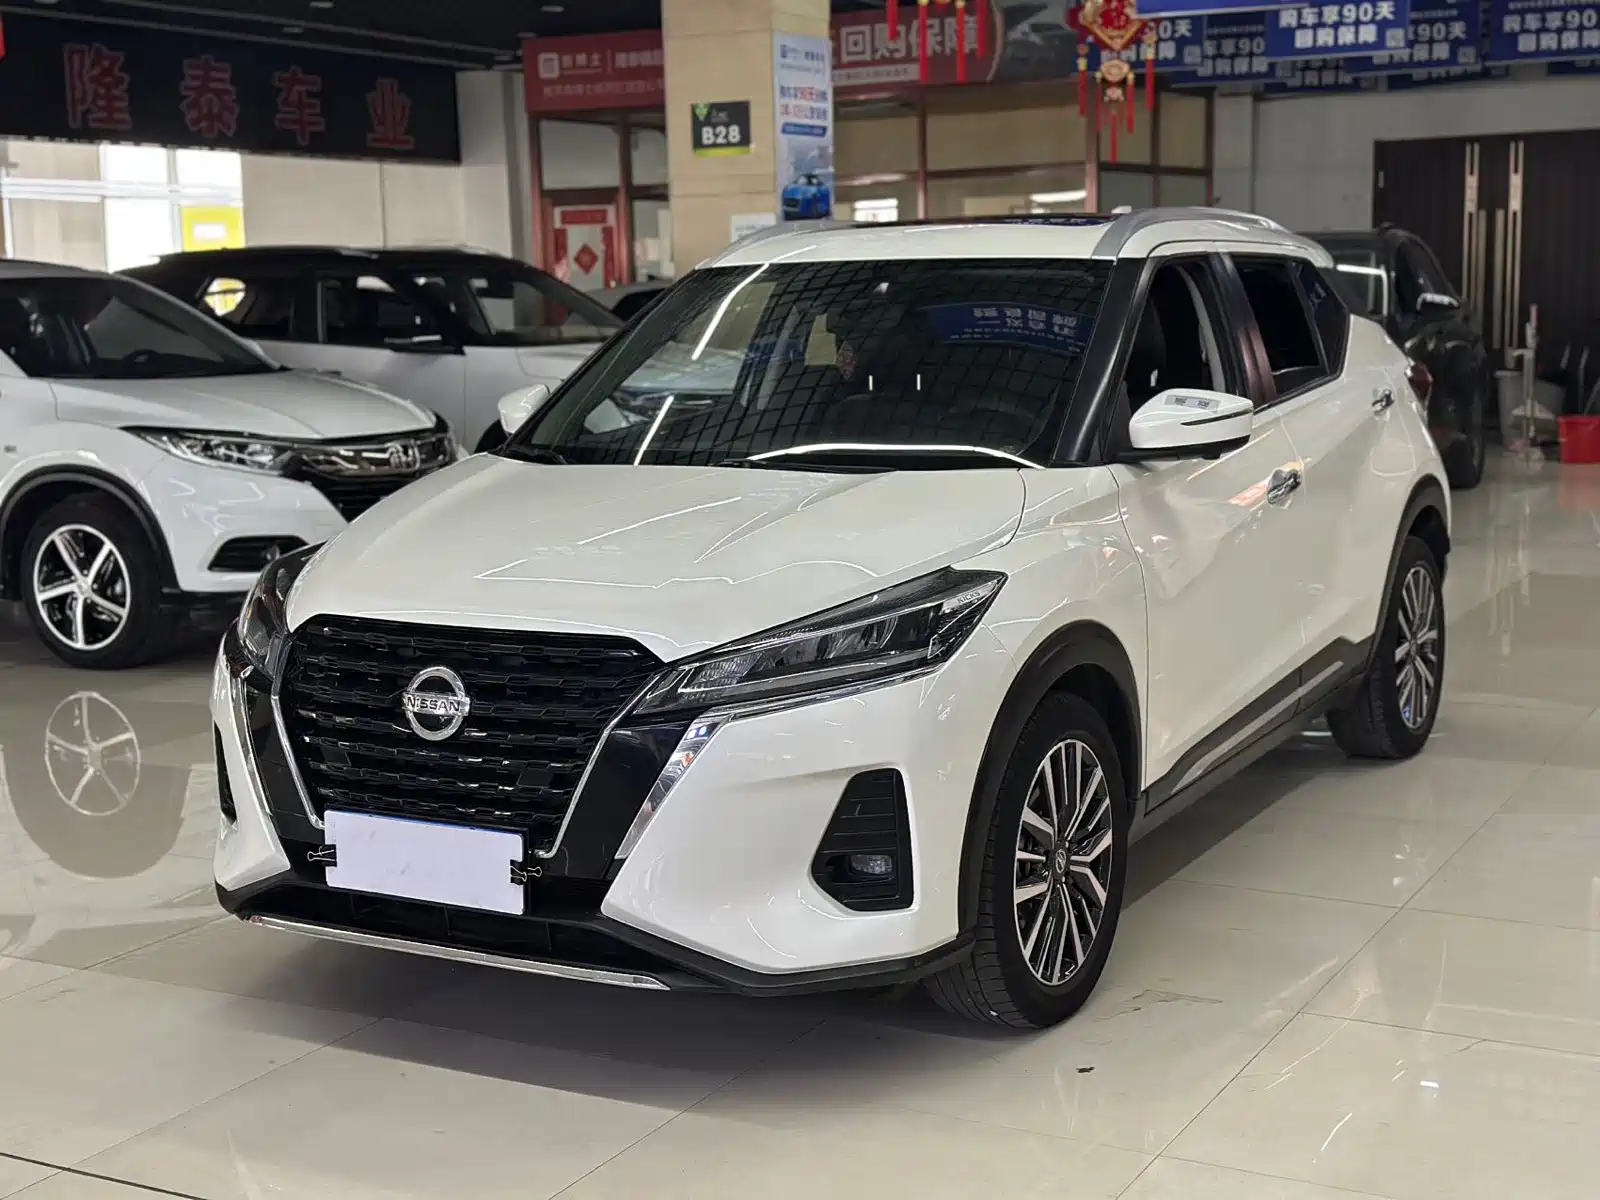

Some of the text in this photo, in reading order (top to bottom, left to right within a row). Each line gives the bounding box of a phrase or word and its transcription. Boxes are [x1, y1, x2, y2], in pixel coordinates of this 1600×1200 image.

[1279, 1, 1395, 28] 购车享90天
[64, 43, 415, 149] 隆泰车业
[701, 124, 742, 146] B28
[406, 695, 460, 712] NISSAN
